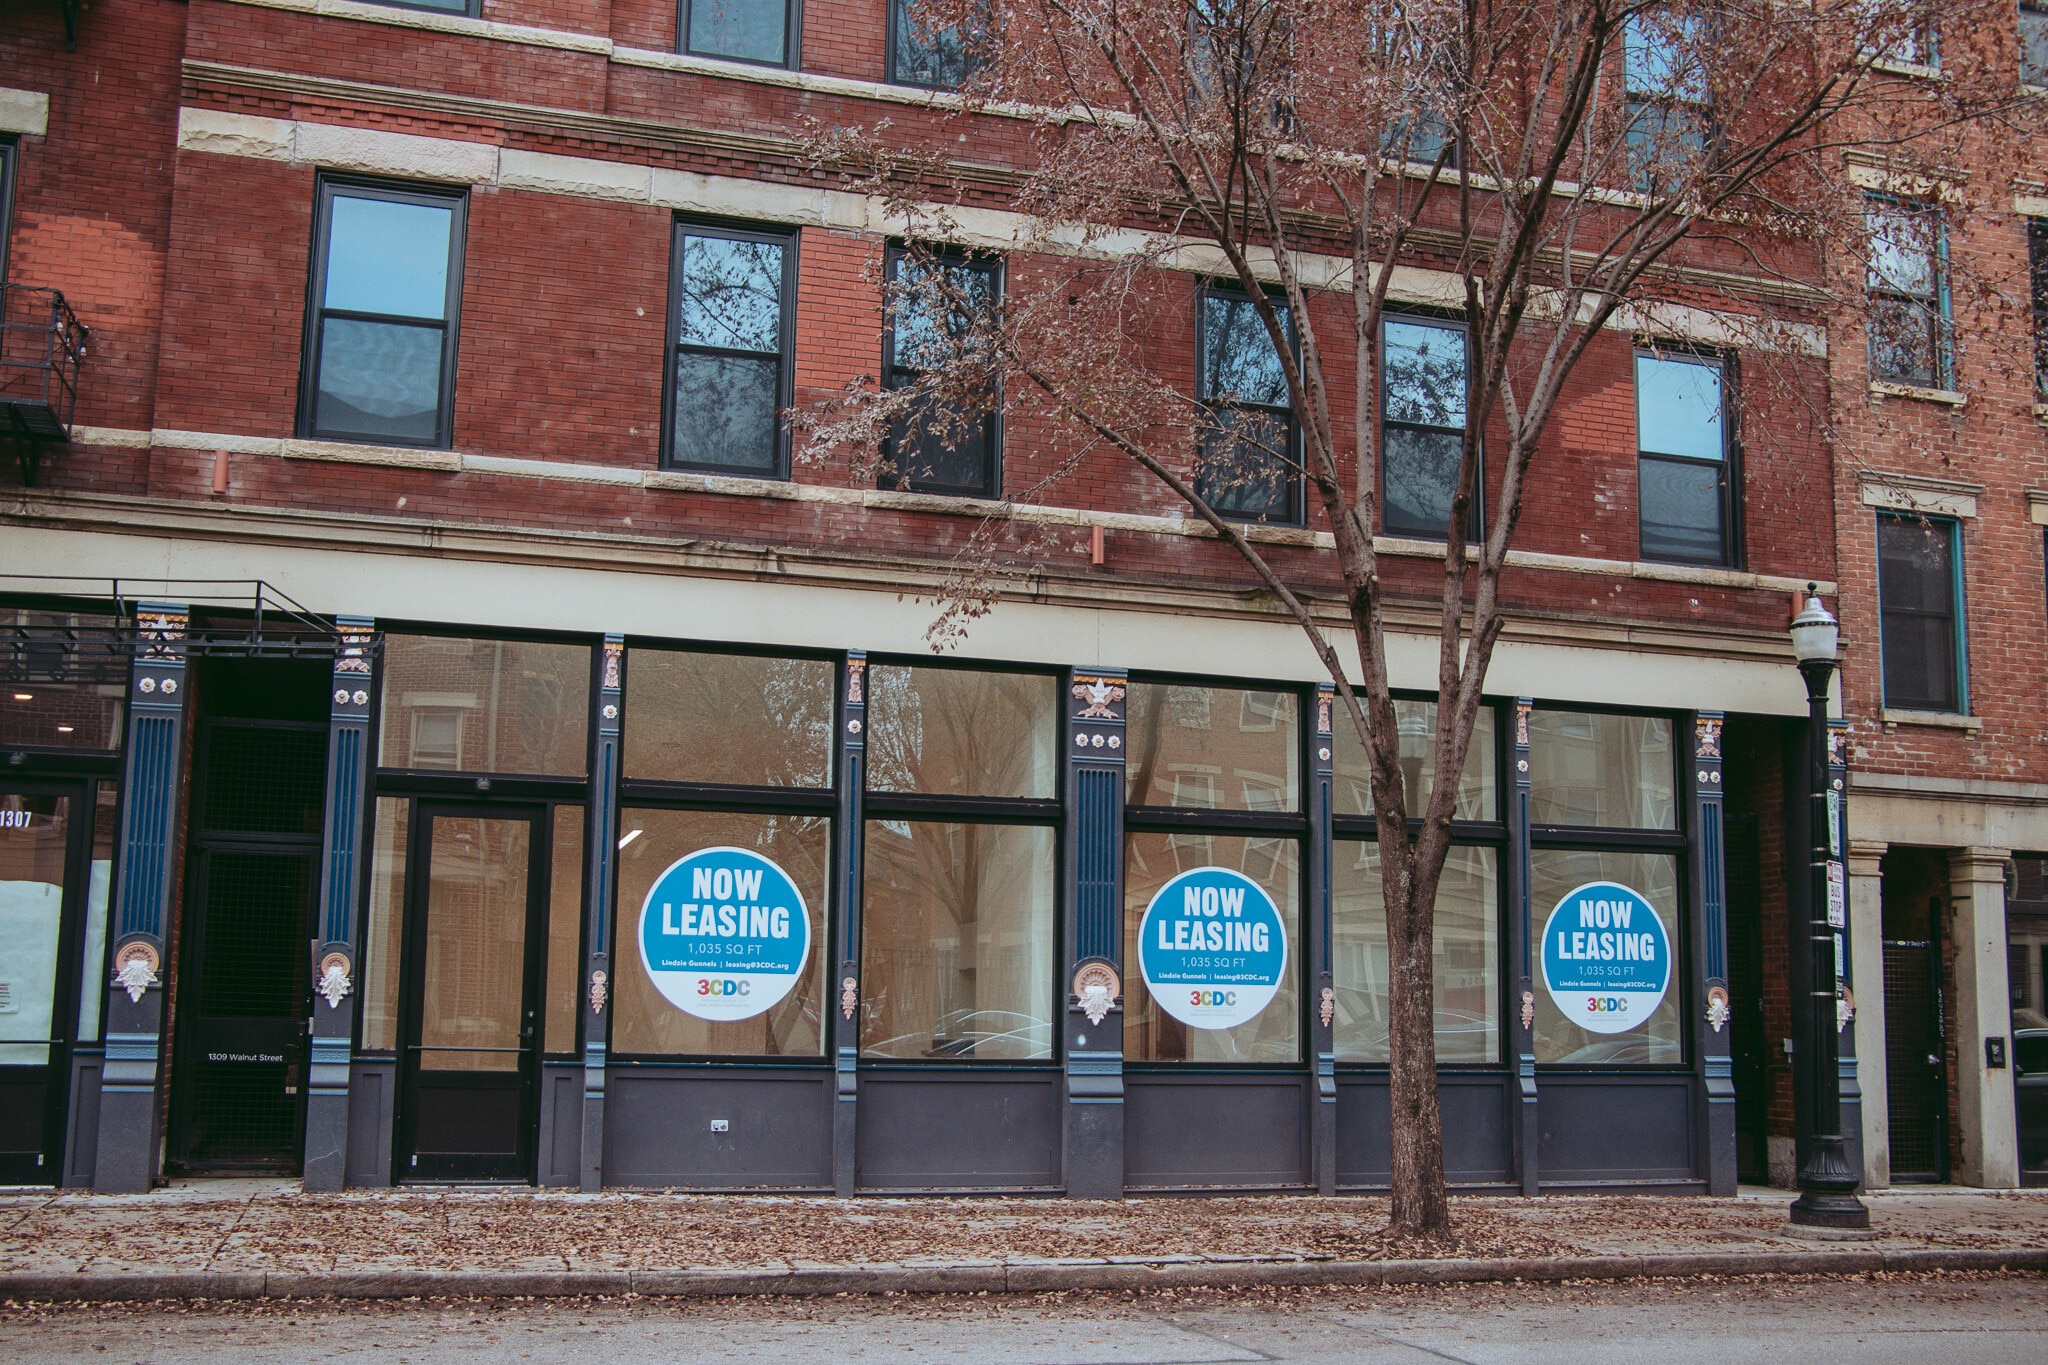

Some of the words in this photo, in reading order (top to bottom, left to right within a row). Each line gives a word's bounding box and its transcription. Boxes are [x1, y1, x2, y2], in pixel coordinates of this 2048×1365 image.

[0, 810, 32, 828] 1307
[692, 867, 763, 902] NOW
[1830, 884, 1841, 898] BUS
[1183, 886, 1245, 918] NOW
[1830, 900, 1842, 913] STOP
[662, 902, 790, 939] LEASING
[1579, 900, 1633, 929] NOW
[1158, 919, 1269, 952] LEASING
[688, 943, 722, 955] 1,035
[726, 944, 744, 955] SQ
[748, 944, 762, 955] FT
[1558, 931, 1655, 961] LEASING
[661, 959, 687, 967] Lindzie
[725, 961, 789, 970] leasing@3CDC.org
[1181, 957, 1211, 968] 1,035
[1214, 957, 1230, 968] SQ
[1233, 958, 1246, 968] FT
[1214, 973, 1270, 982] leasing@3CDC.org
[1578, 966, 1605, 977] 1,035
[1607, 966, 1621, 976] SQ
[1624, 966, 1635, 976] FT
[697, 979, 751, 996] 3CDC
[1189, 990, 1237, 1007] 3CDC
[1587, 997, 1628, 1012] 3CDC
[208, 1053, 228, 1061] 1309
[229, 1053, 257, 1061] Walnut
[259, 1053, 283, 1062] Street
